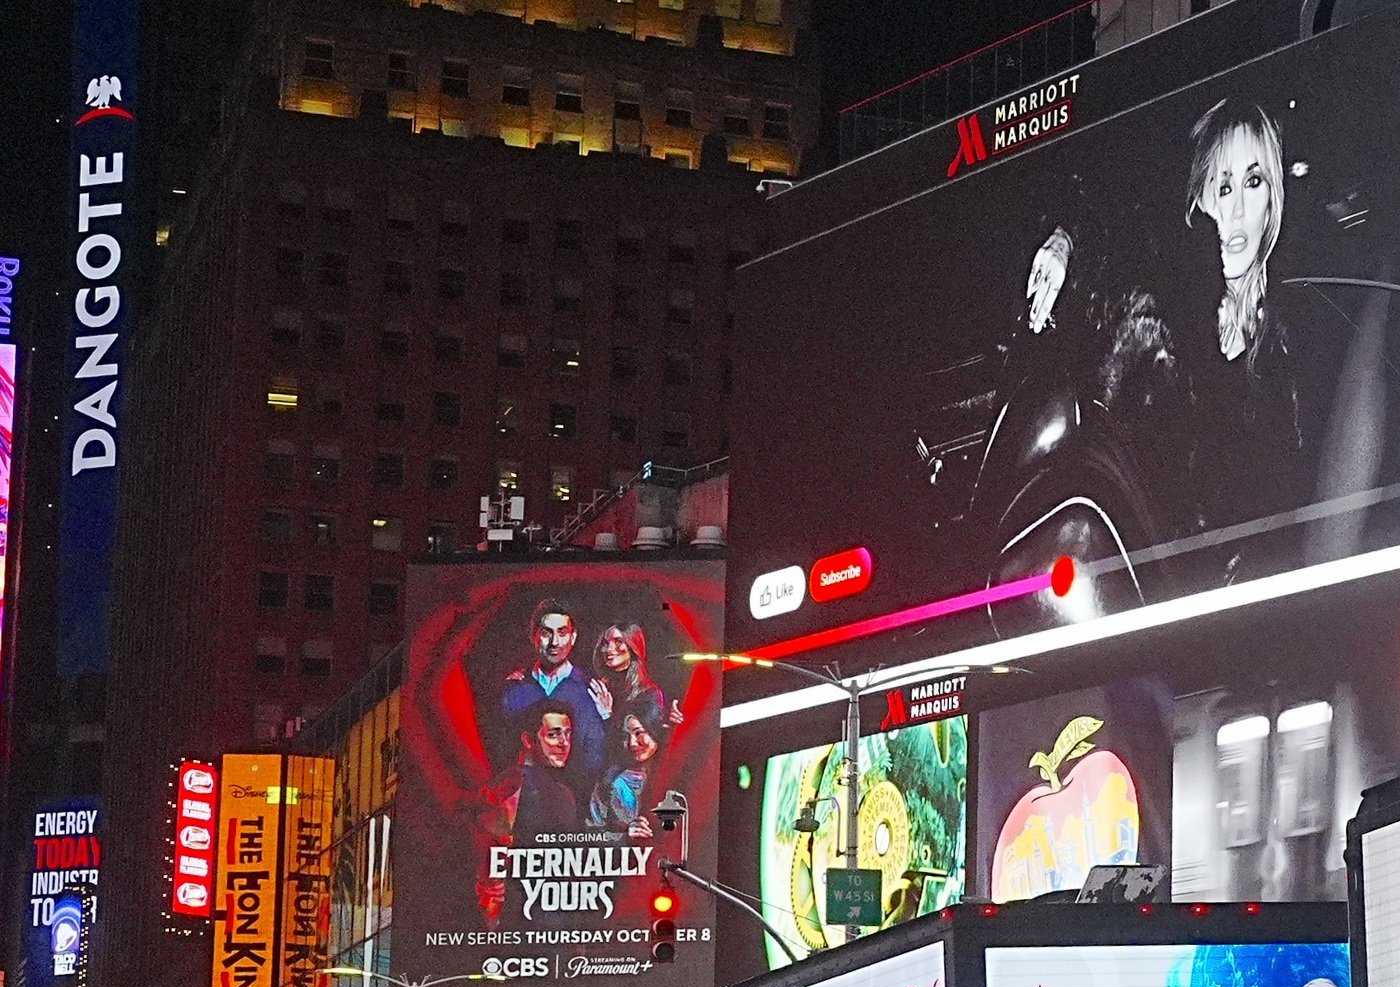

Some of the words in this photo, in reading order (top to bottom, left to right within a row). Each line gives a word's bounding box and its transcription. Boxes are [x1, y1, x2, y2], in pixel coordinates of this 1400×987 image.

[995, 74, 1080, 125] MARRIOTT
[994, 105, 1068, 151] MARQUIS
[71, 151, 124, 477] DANGOTE
[820, 564, 861, 586] Subscribe
[776, 583, 794, 599] Like
[911, 676, 967, 700] MARRIOTT
[911, 695, 960, 718] MARQUIS
[35, 810, 98, 837] ENERGY
[239, 816, 264, 864] THE
[535, 834, 557, 842] CBS
[558, 832, 609, 842] ORIGINAL
[33, 835, 101, 870] TODAY
[489, 847, 654, 878] ETERNALLY
[848, 875, 862, 886] TO
[520, 879, 615, 921] YOURS
[833, 890, 843, 901] W
[425, 932, 464, 945] NEW
[467, 931, 522, 945] SERIES
[525, 930, 613, 944] THURSDAY
[617, 929, 697, 942] OCTER
[701, 928, 711, 941] 8
[53, 953, 76, 964] TACO
[53, 963, 76, 976] BELL
[503, 957, 549, 977] CBS
